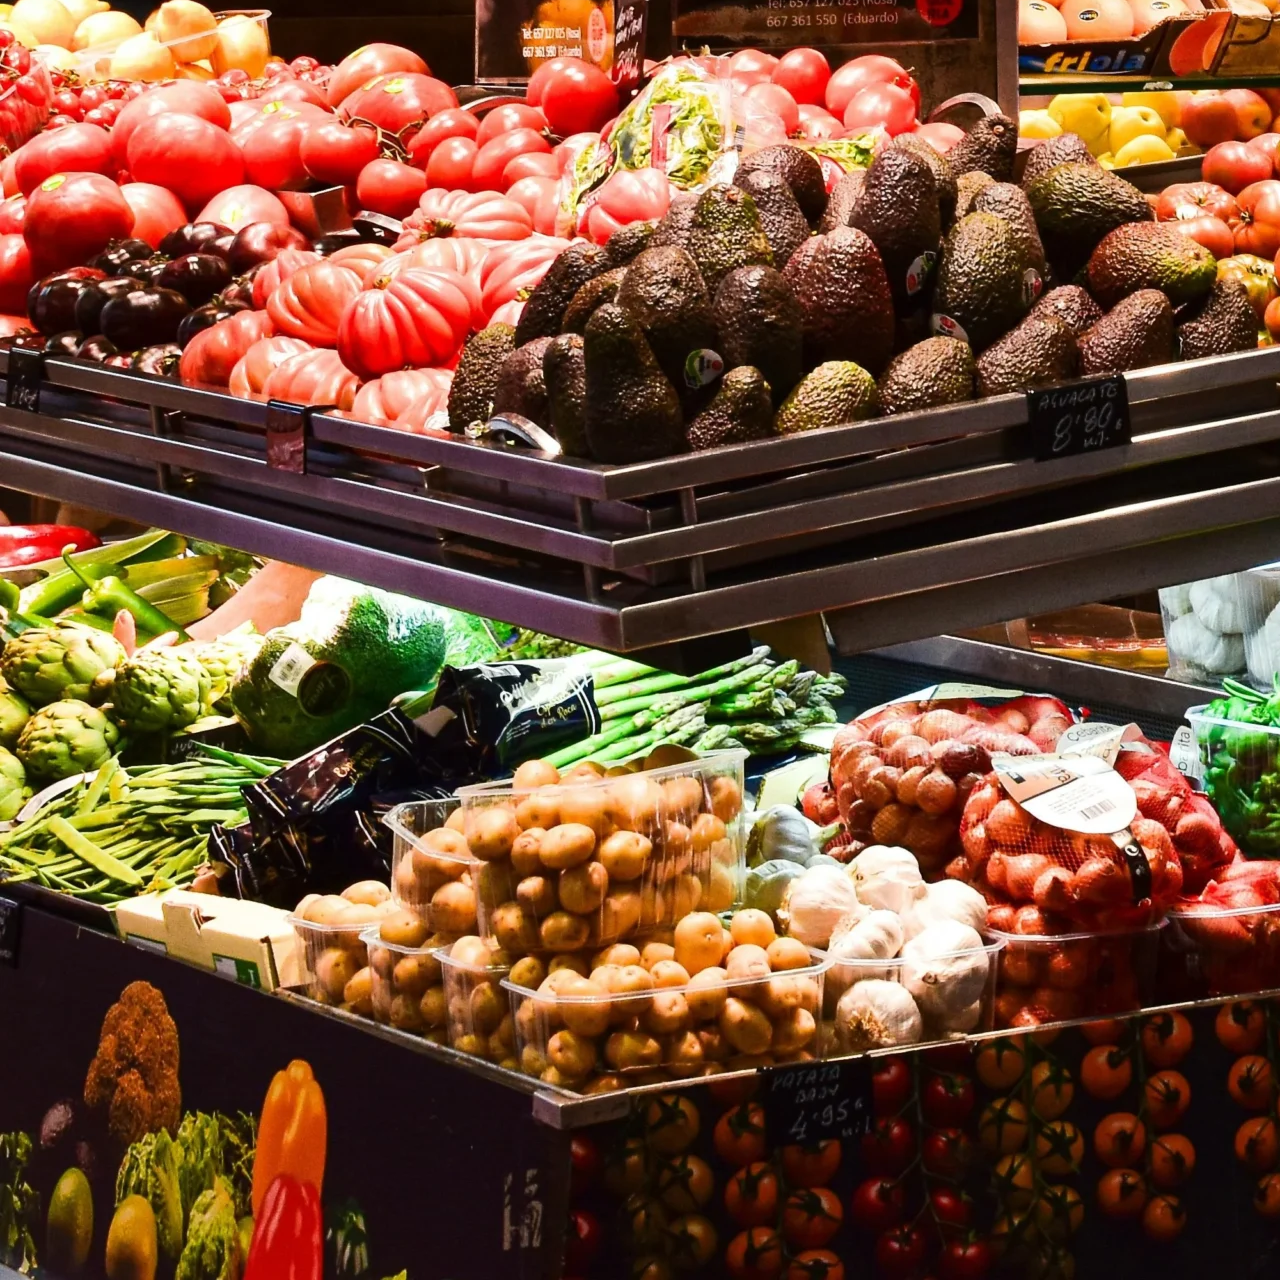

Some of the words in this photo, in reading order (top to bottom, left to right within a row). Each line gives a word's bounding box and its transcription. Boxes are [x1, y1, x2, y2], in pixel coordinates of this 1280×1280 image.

[766, 16, 788, 27] 667
[791, 15, 812, 26] 361
[816, 14, 837, 25] 550
[843, 11, 899, 26] (Eduardo)
[1043, 49, 1146, 72] friola
[1039, 382, 1119, 410] AGUACATE
